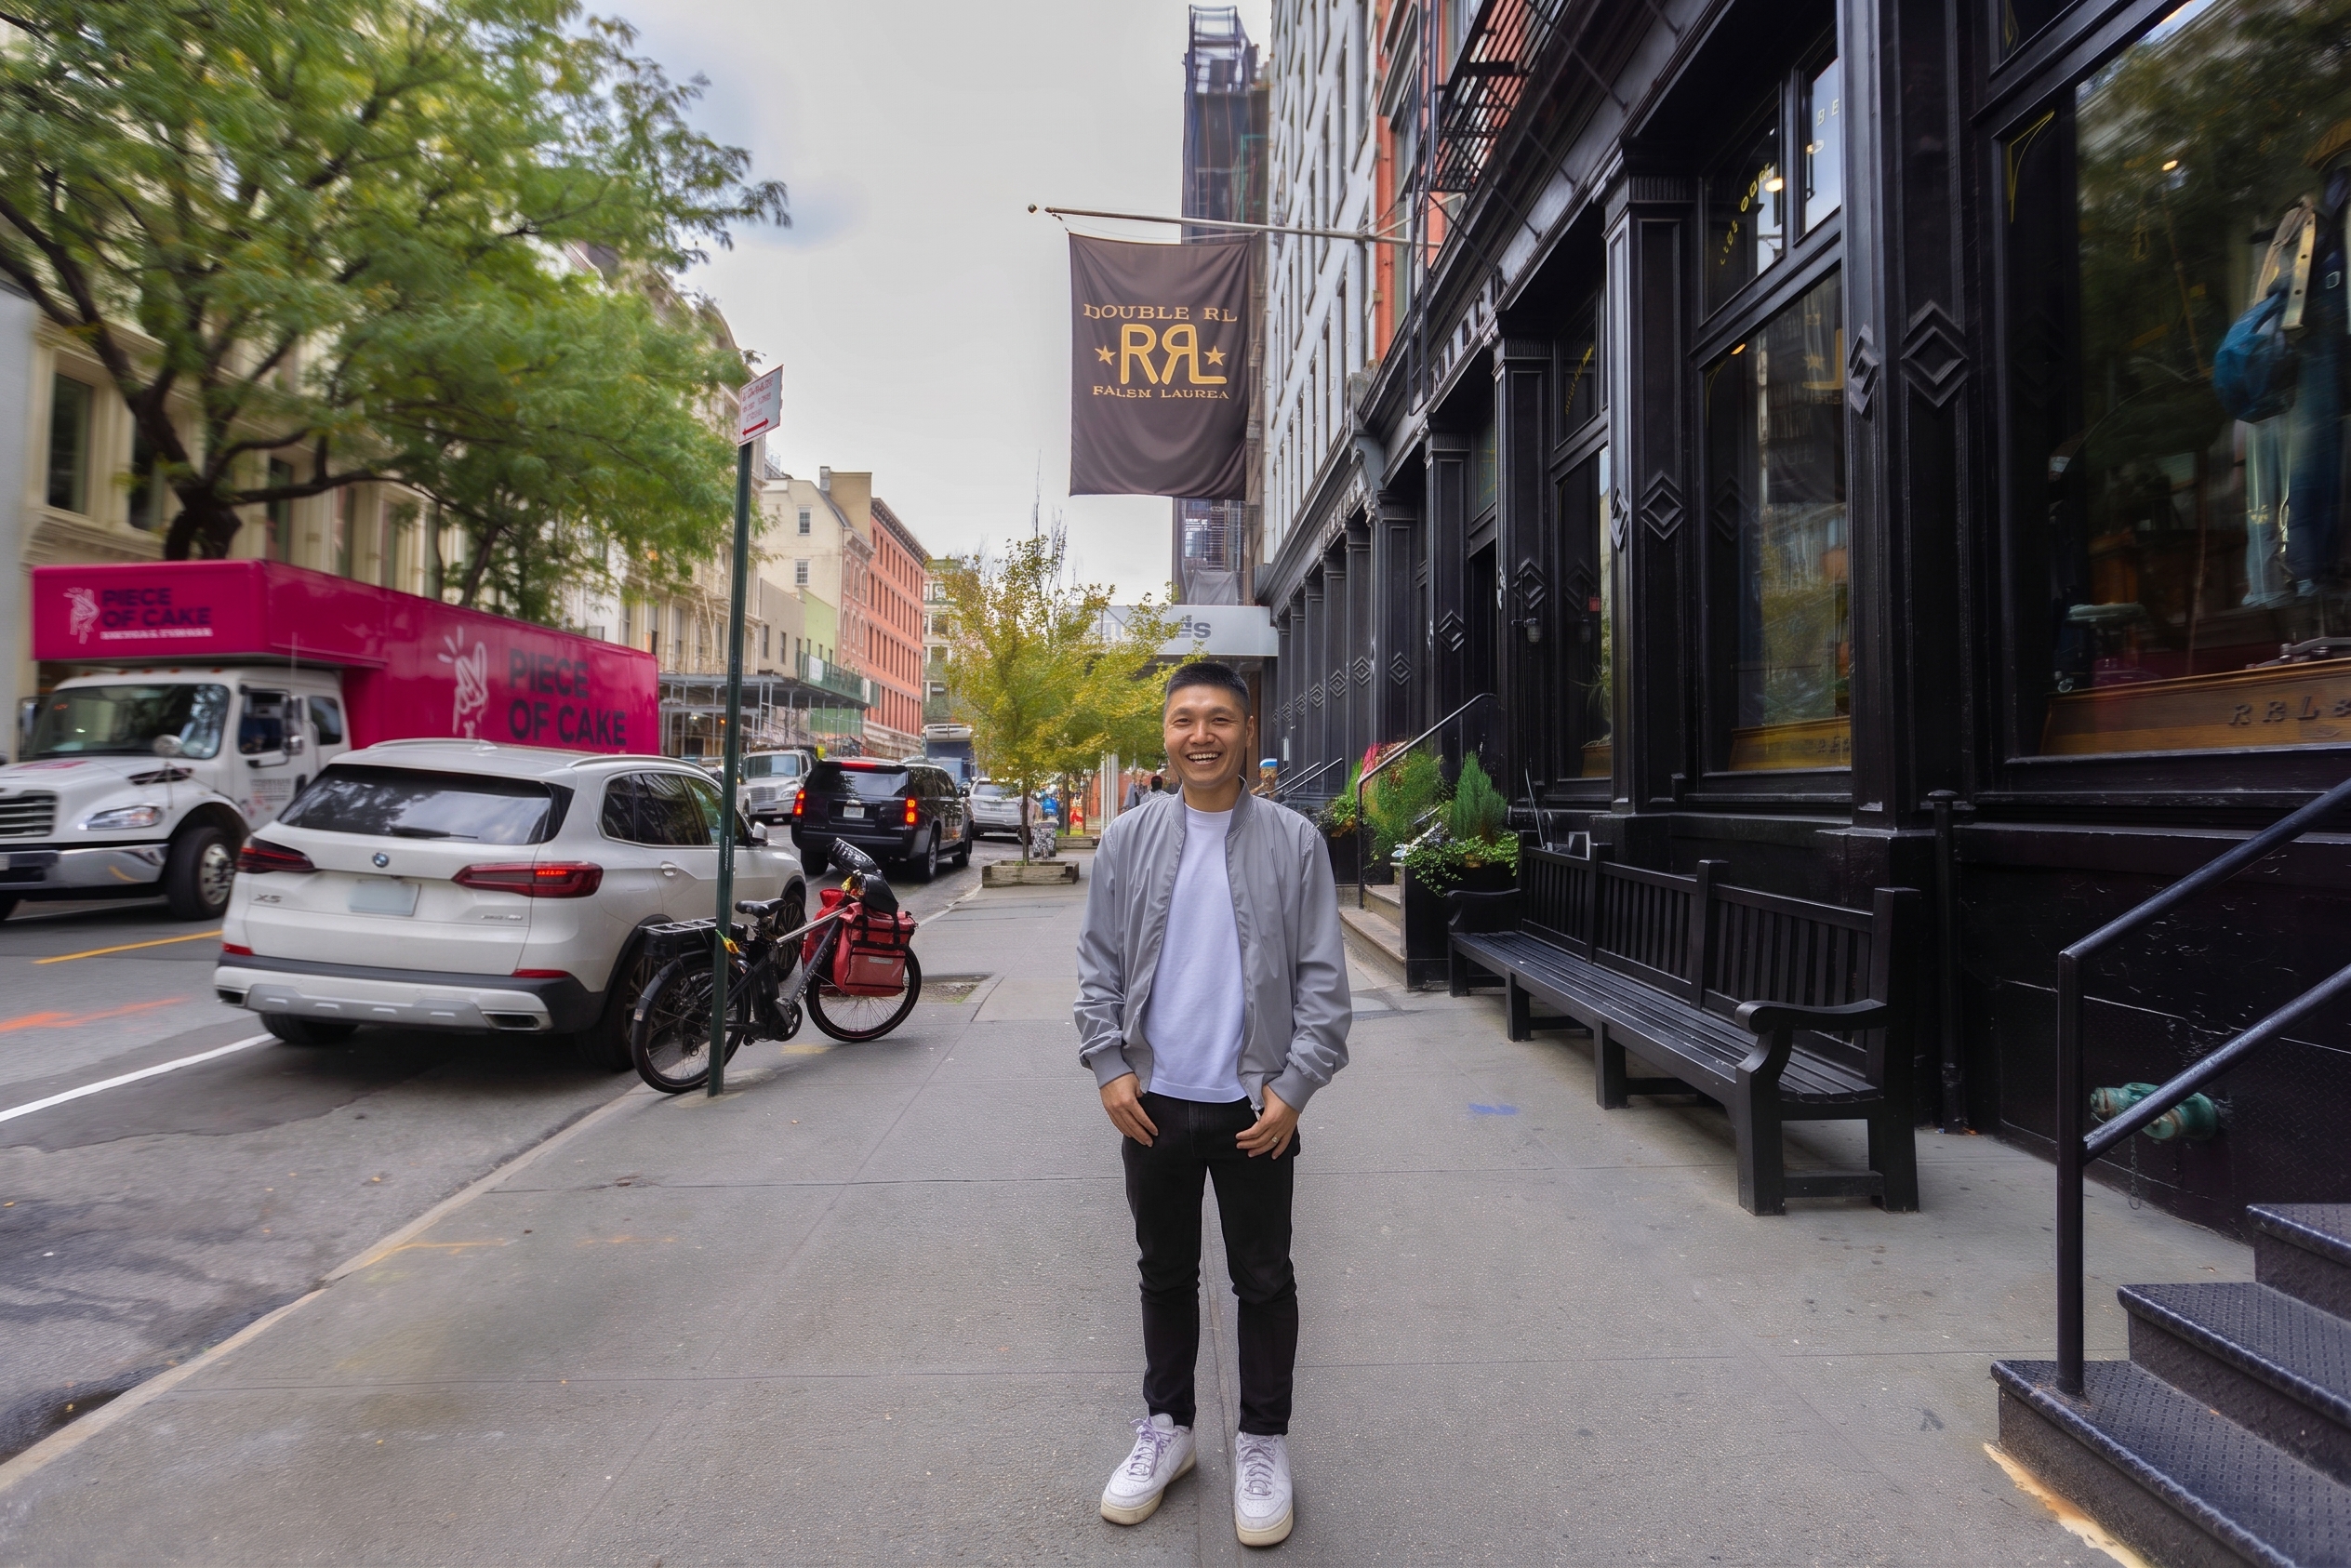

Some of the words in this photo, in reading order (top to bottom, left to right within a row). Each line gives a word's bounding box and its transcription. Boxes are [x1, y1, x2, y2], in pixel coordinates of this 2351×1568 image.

[1083, 303, 1189, 321] DOUBLE
[1203, 307, 1238, 323] RL
[101, 588, 172, 606] PIECE
[102, 608, 136, 628] OF
[142, 606, 212, 628] CAKE
[508, 647, 590, 700] PIECE
[509, 698, 551, 741] OF
[558, 704, 627, 746] CAKE
